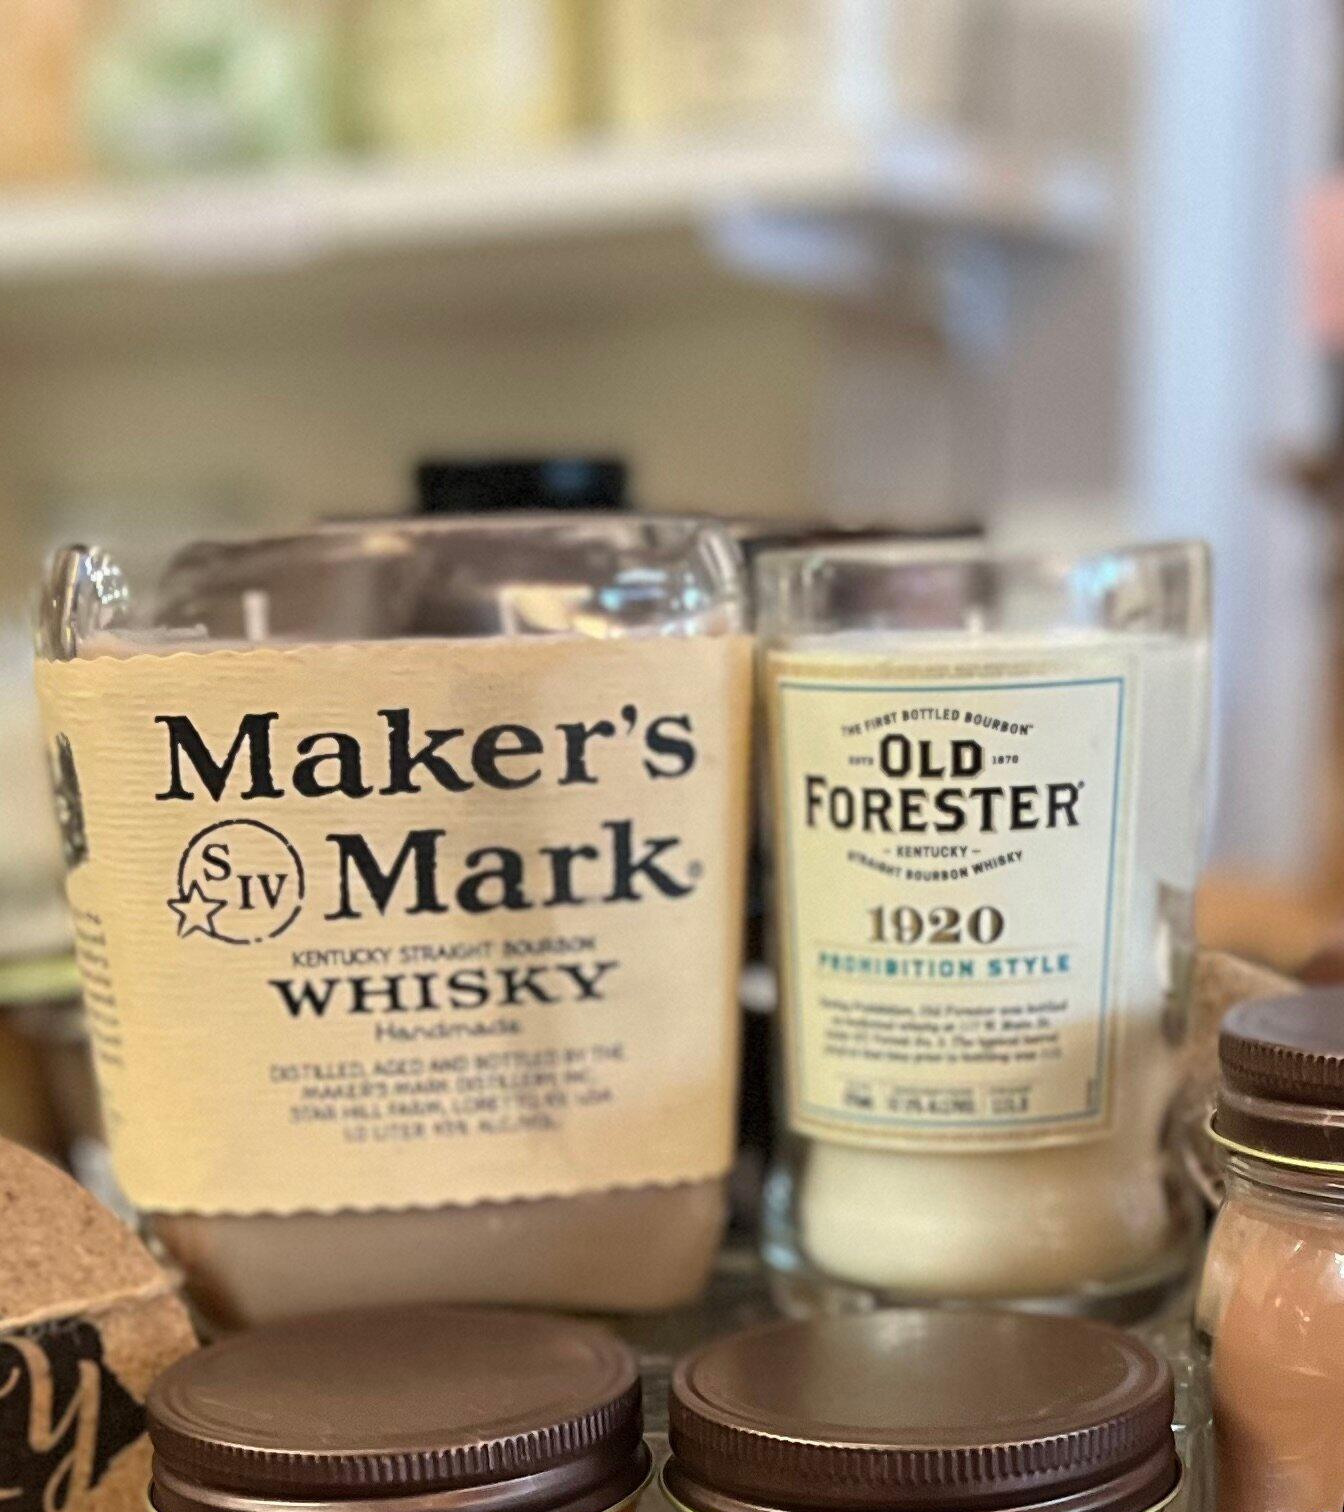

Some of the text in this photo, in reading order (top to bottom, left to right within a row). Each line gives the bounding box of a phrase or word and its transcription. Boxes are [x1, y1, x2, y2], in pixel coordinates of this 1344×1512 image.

[841, 708, 1029, 738] THE FIRST BOTTLED BOURBON
[155, 703, 698, 803] Maker's
[879, 732, 985, 779] OLD
[991, 754, 1019, 765] 1870
[805, 773, 1081, 833] FORESTER
[847, 850, 1023, 881] STRAIGHT BOURBON WHISKY
[895, 845, 969, 858] KENTUCKY
[324, 820, 694, 922] Mark
[867, 904, 1006, 946] 1920
[292, 936, 597, 969] KENTUCKY STRAIGHT BOURBON
[816, 951, 1071, 979] PROHIBITION STYLE
[268, 960, 620, 1019] WHISKY
[375, 1017, 523, 1042] Handmade
